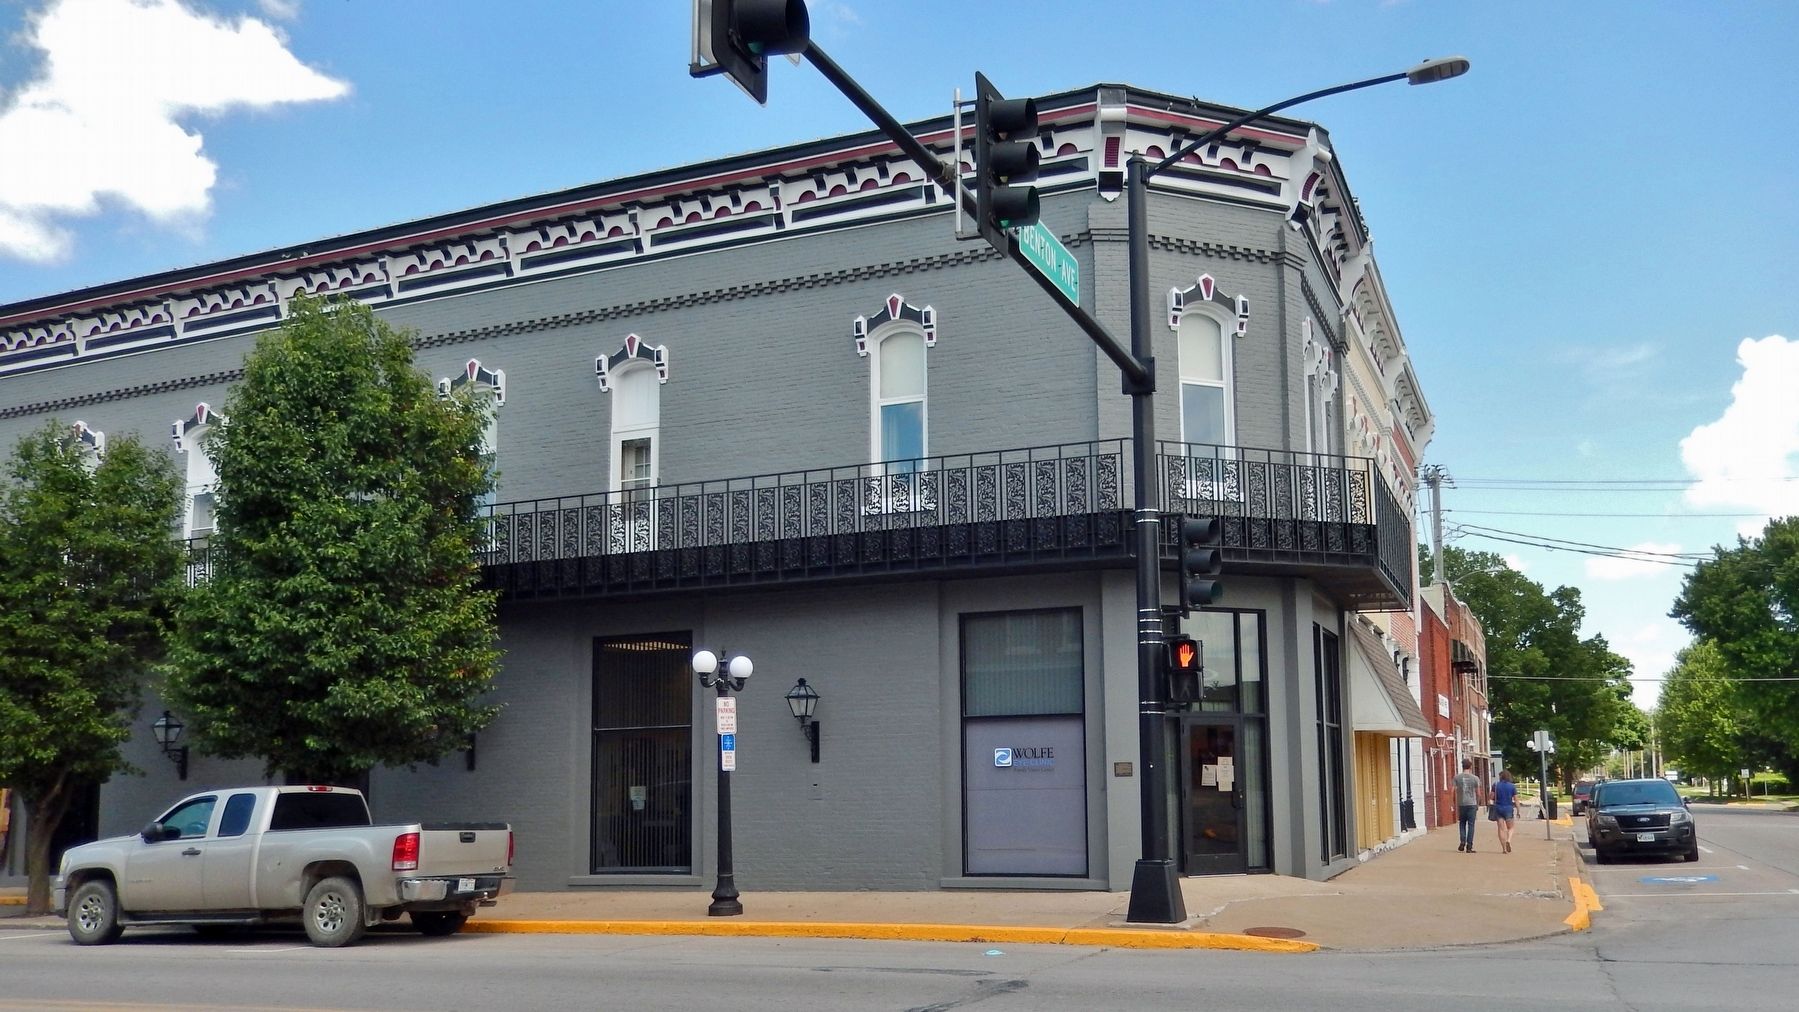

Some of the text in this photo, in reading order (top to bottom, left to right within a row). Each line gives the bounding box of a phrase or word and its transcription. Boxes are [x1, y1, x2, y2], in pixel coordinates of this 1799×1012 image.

[1023, 225, 1076, 293] BENTON AVE
[1012, 747, 1055, 759] WOLFE
